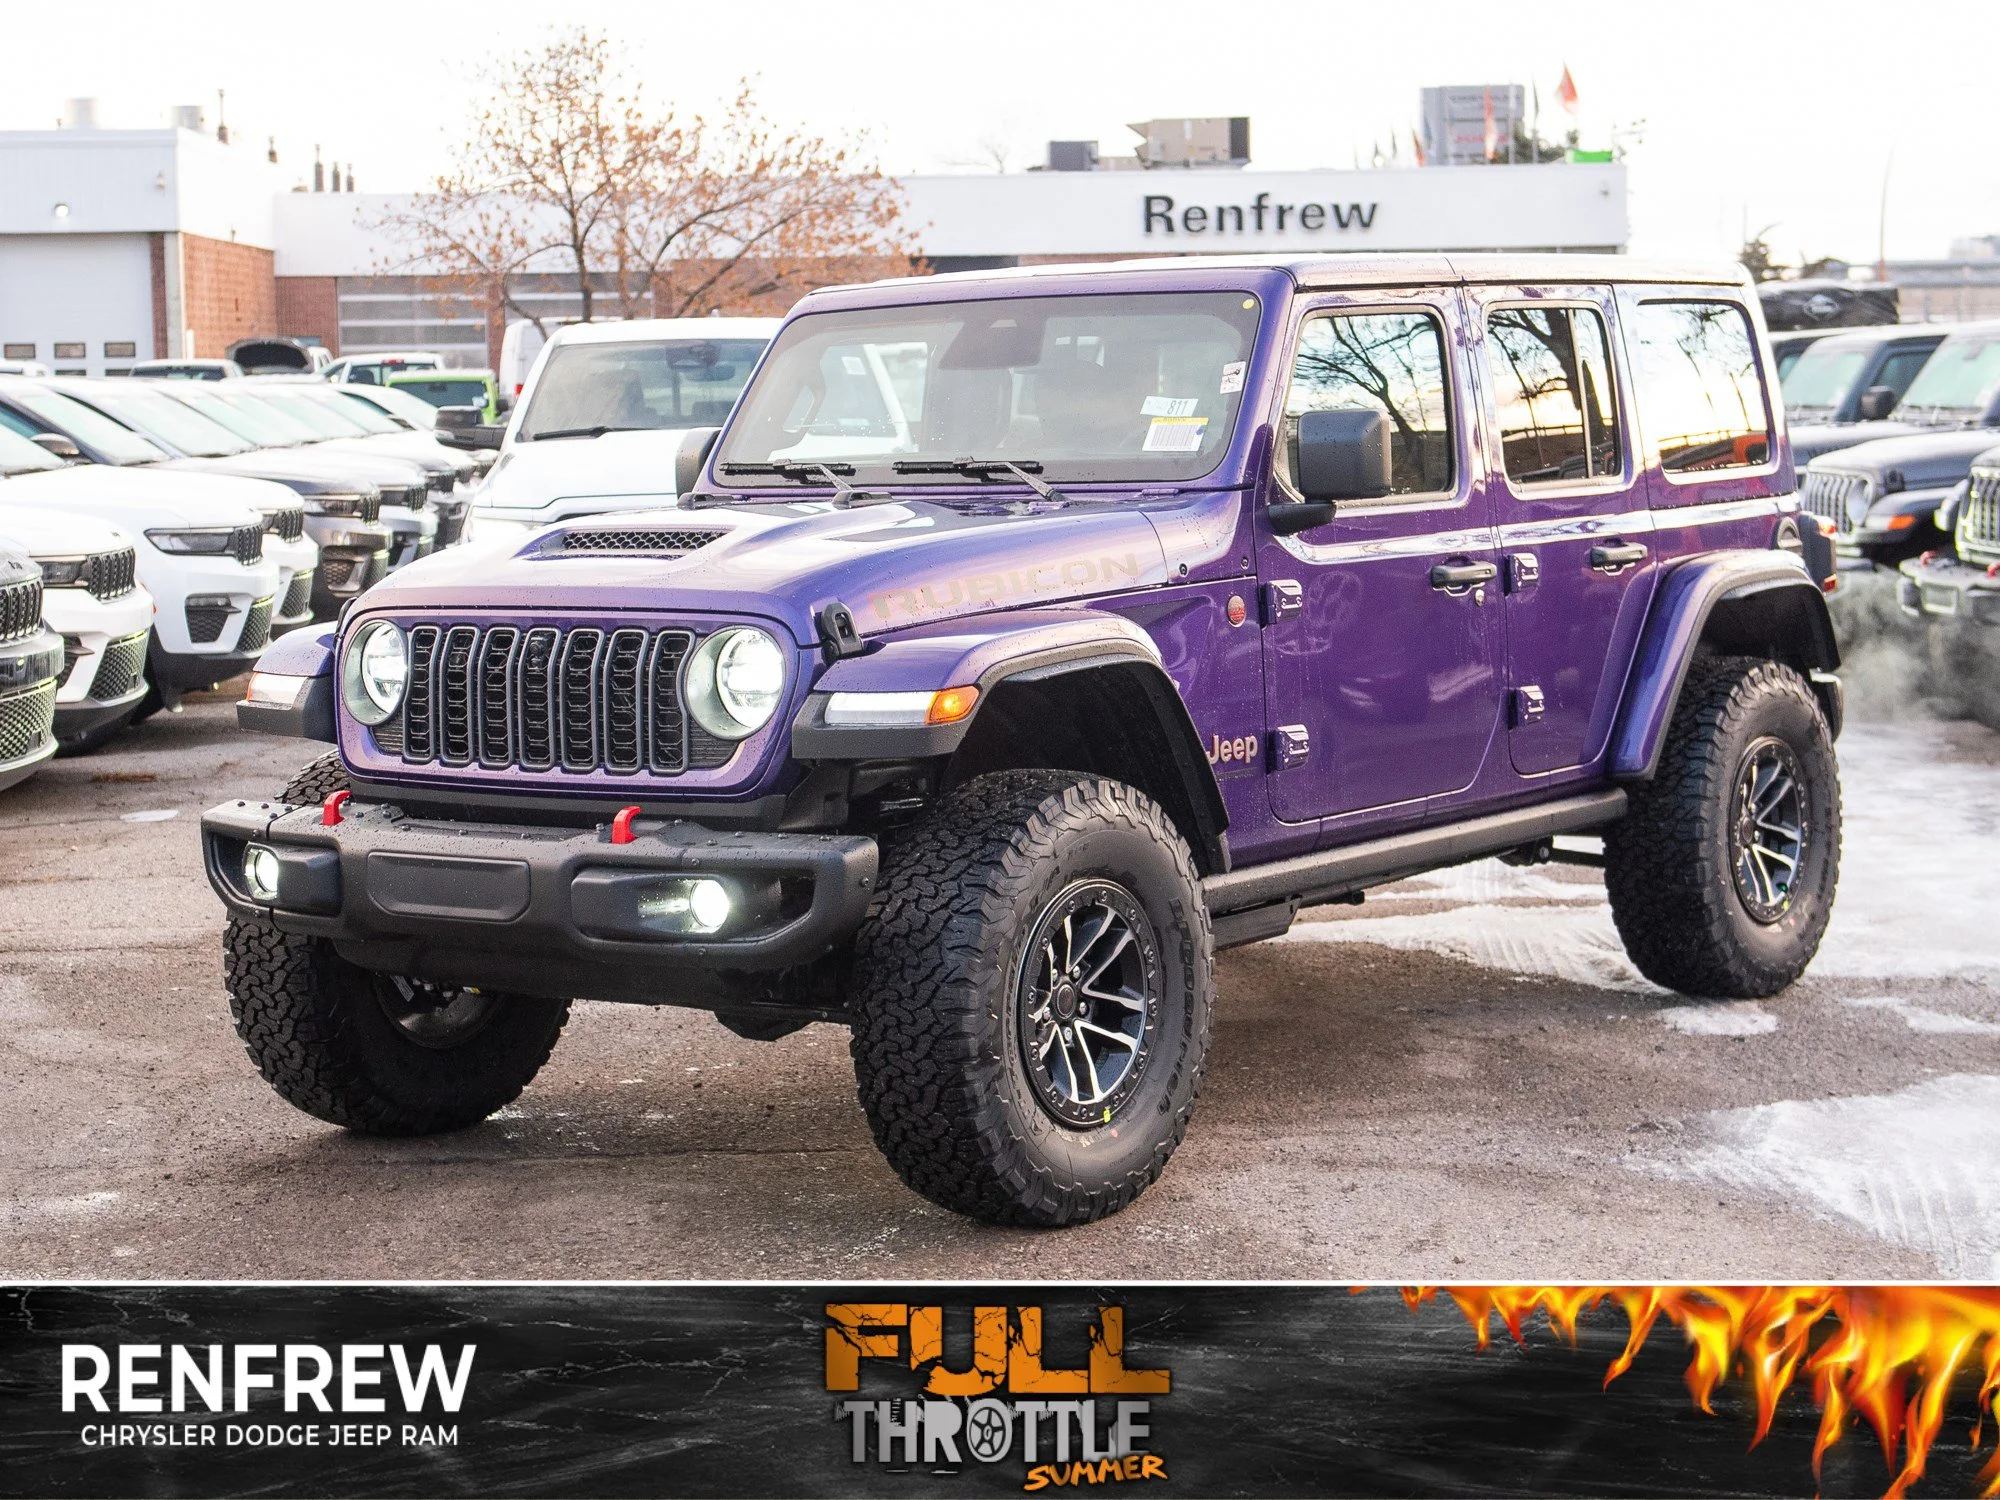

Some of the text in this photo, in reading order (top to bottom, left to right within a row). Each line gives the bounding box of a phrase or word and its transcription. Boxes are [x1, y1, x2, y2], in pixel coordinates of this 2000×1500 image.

[1143, 192, 1378, 234] Renfrew
[869, 552, 1139, 619] RUBICON
[1206, 734, 1258, 765] Jeep
